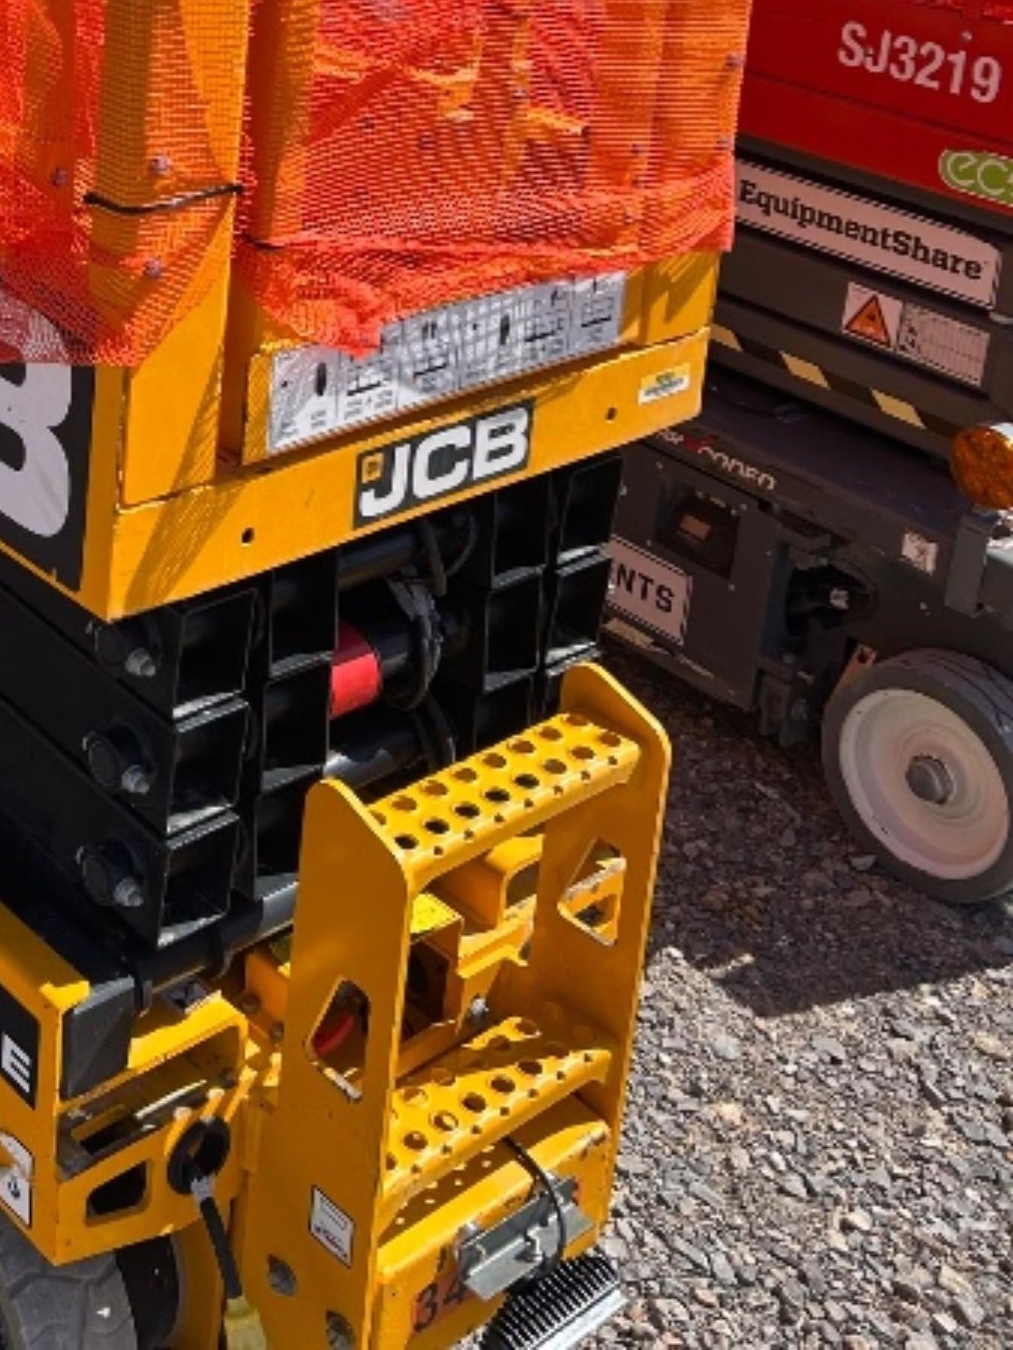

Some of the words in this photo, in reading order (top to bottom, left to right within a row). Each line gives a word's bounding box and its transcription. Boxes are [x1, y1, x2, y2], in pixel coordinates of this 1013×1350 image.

[837, 20, 1002, 104] SJ3219
[946, 153, 1013, 198] ec
[739, 179, 983, 281] EquipmentShare
[359, 407, 530, 517] JCB
[610, 563, 674, 613] NTS
